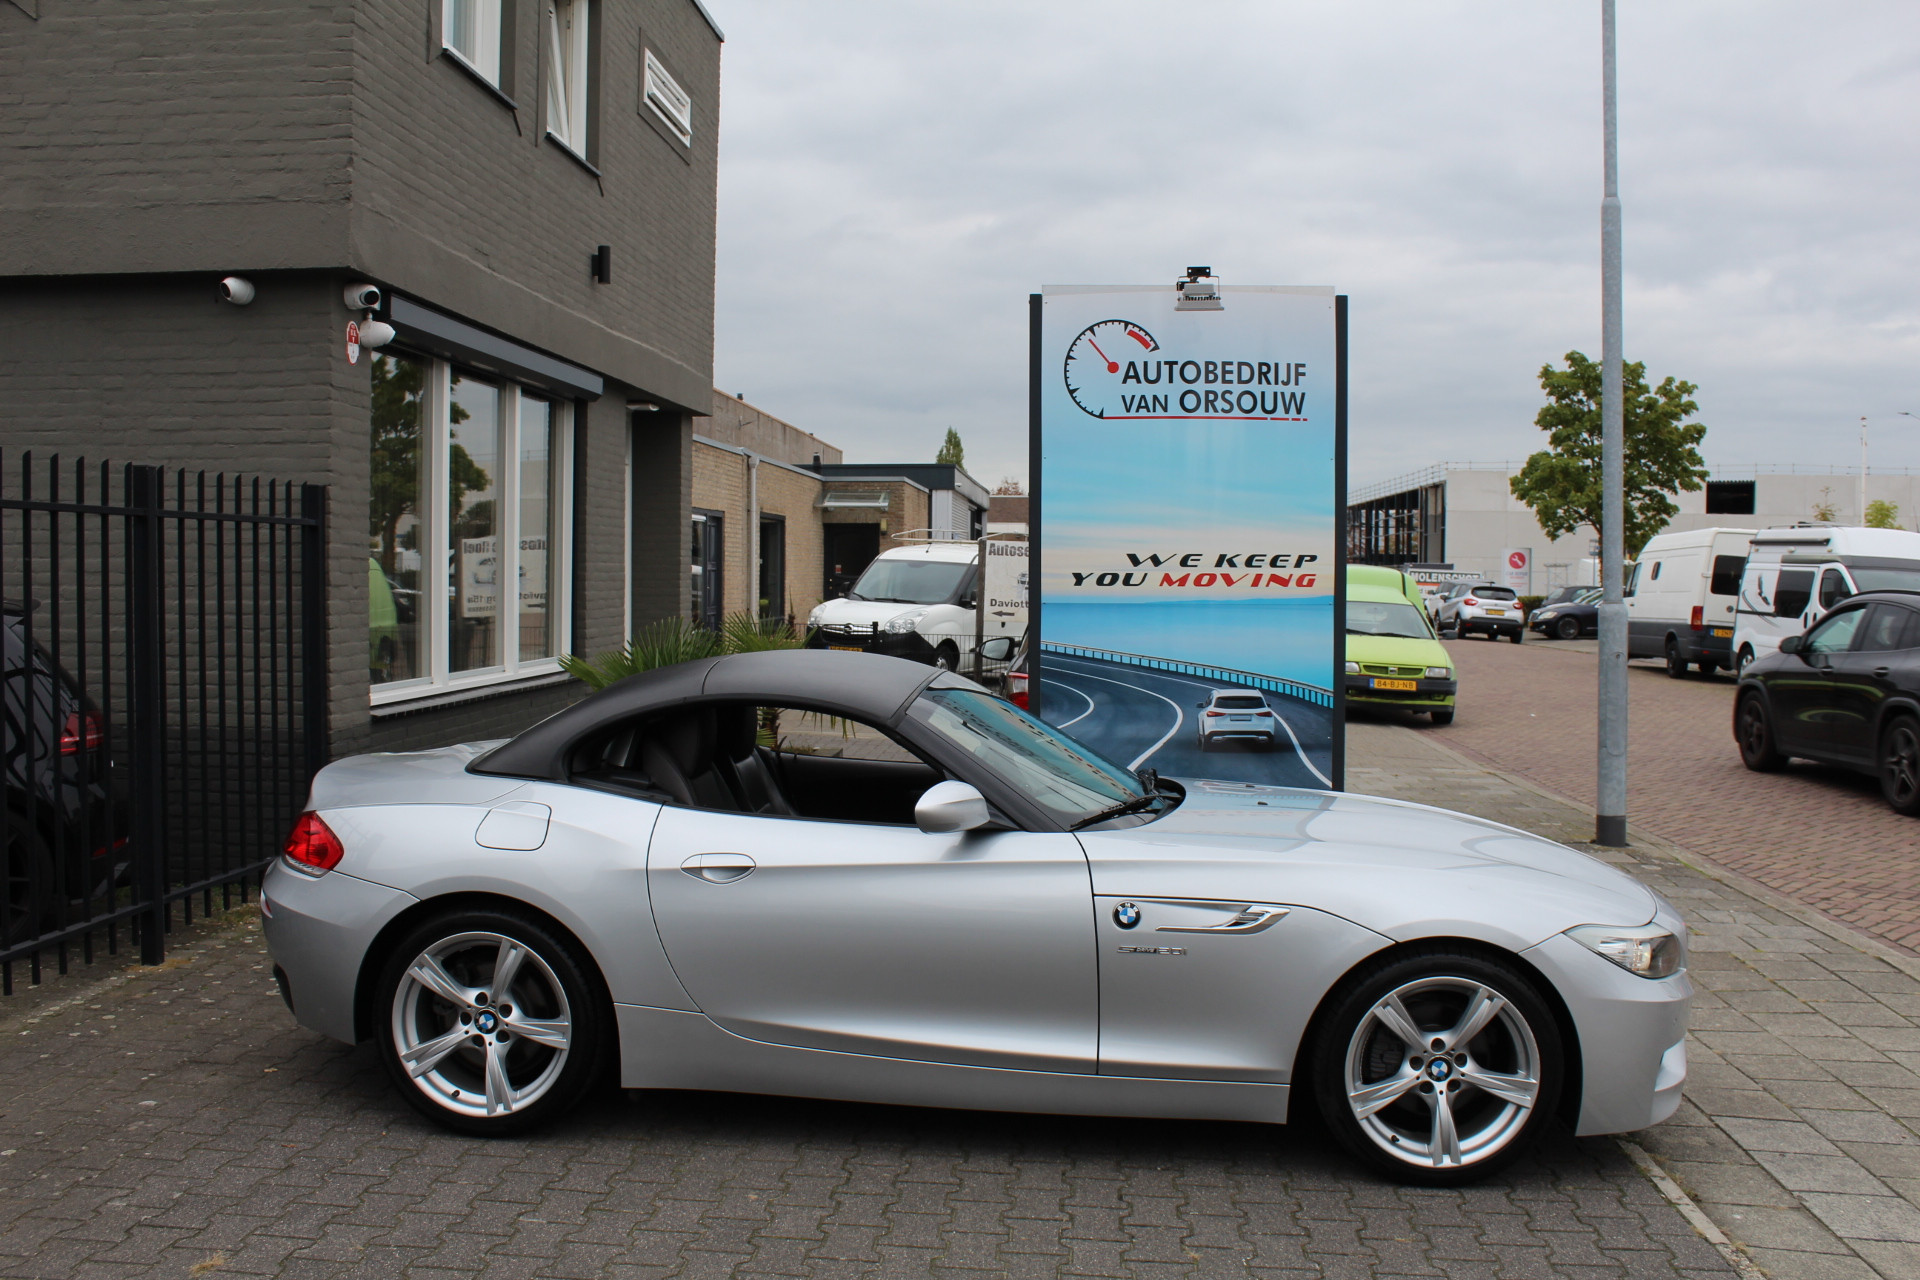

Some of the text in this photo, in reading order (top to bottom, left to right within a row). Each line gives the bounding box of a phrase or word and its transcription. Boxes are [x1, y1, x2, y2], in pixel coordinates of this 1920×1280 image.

[1121, 360, 1307, 386] AUTOBEDRIJF
[1121, 389, 1306, 415] VAN ORSOUW
[1126, 553, 1318, 568] WE KEEP
[1072, 572, 1316, 588] YOU MOVING
